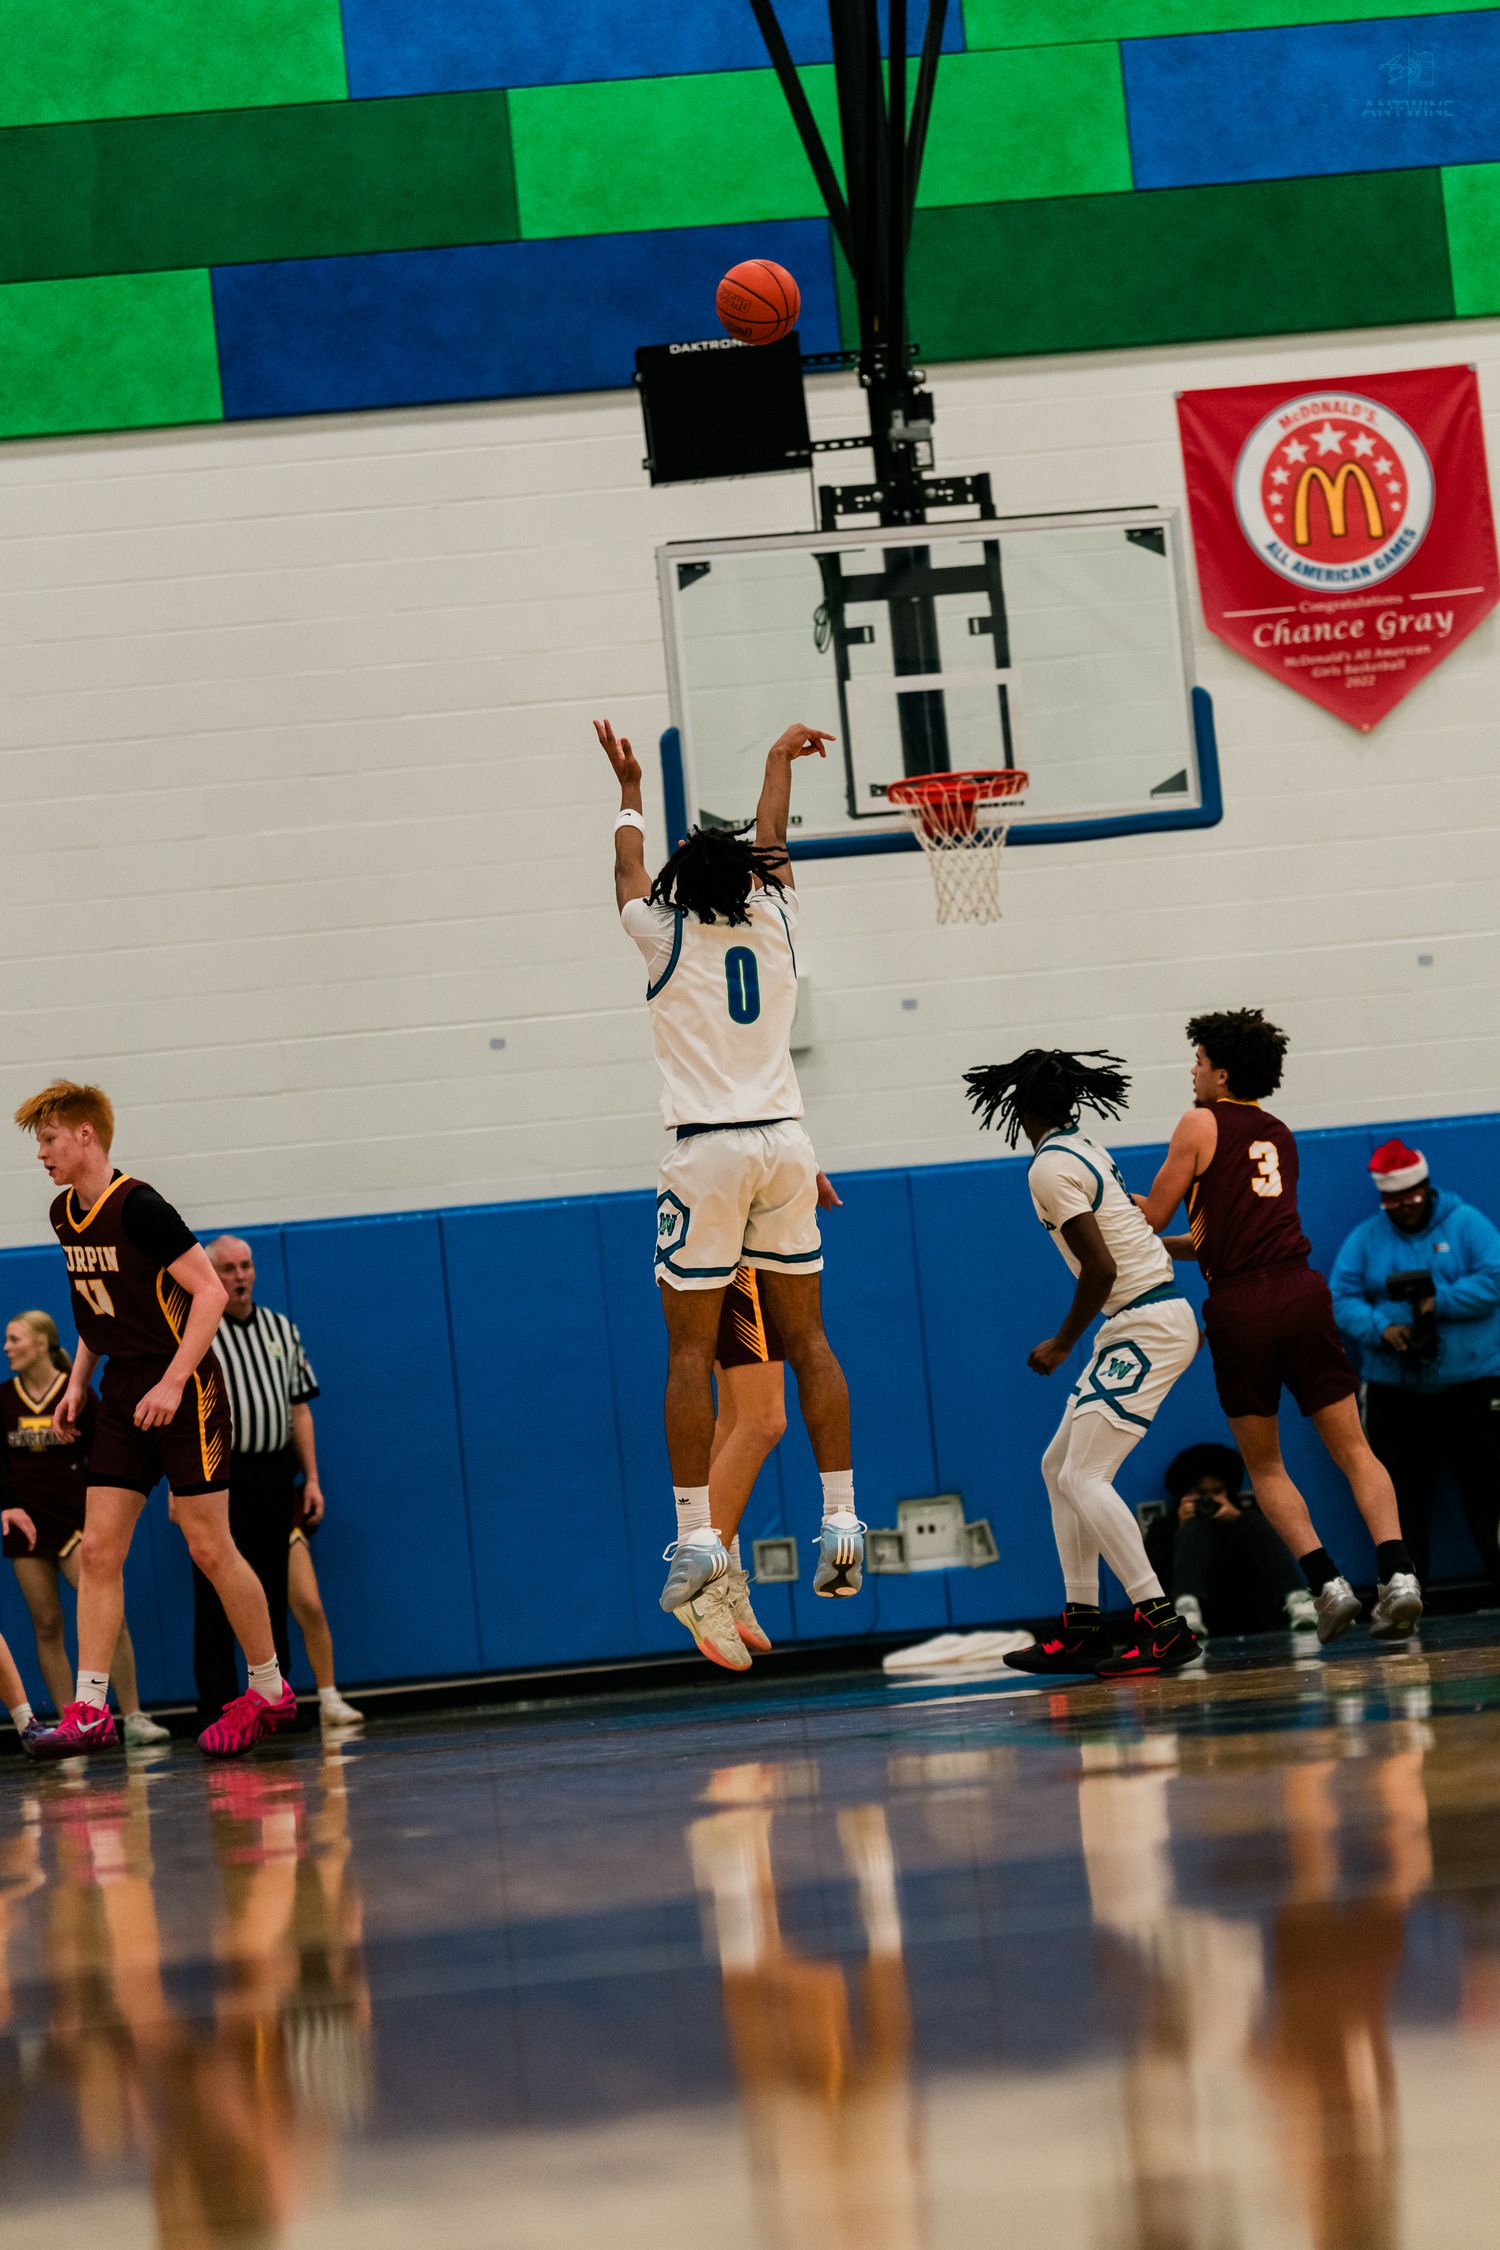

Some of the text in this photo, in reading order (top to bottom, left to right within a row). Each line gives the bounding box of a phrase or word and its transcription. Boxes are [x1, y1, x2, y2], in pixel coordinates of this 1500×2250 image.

[669, 338, 755, 355] DAKTRON
[1266, 528, 1417, 583] ALL AMERICAN GAMES
[1253, 610, 1455, 648] Chance Gray
[1354, 647, 1373, 661] All
[1375, 643, 1431, 659] American
[1311, 658, 1406, 679] Girls Basketball
[1345, 674, 1377, 688] 2022
[724, 945, 761, 1026] 0
[1248, 1140, 1283, 1198] 3
[62, 1245, 119, 1273] URPIN
